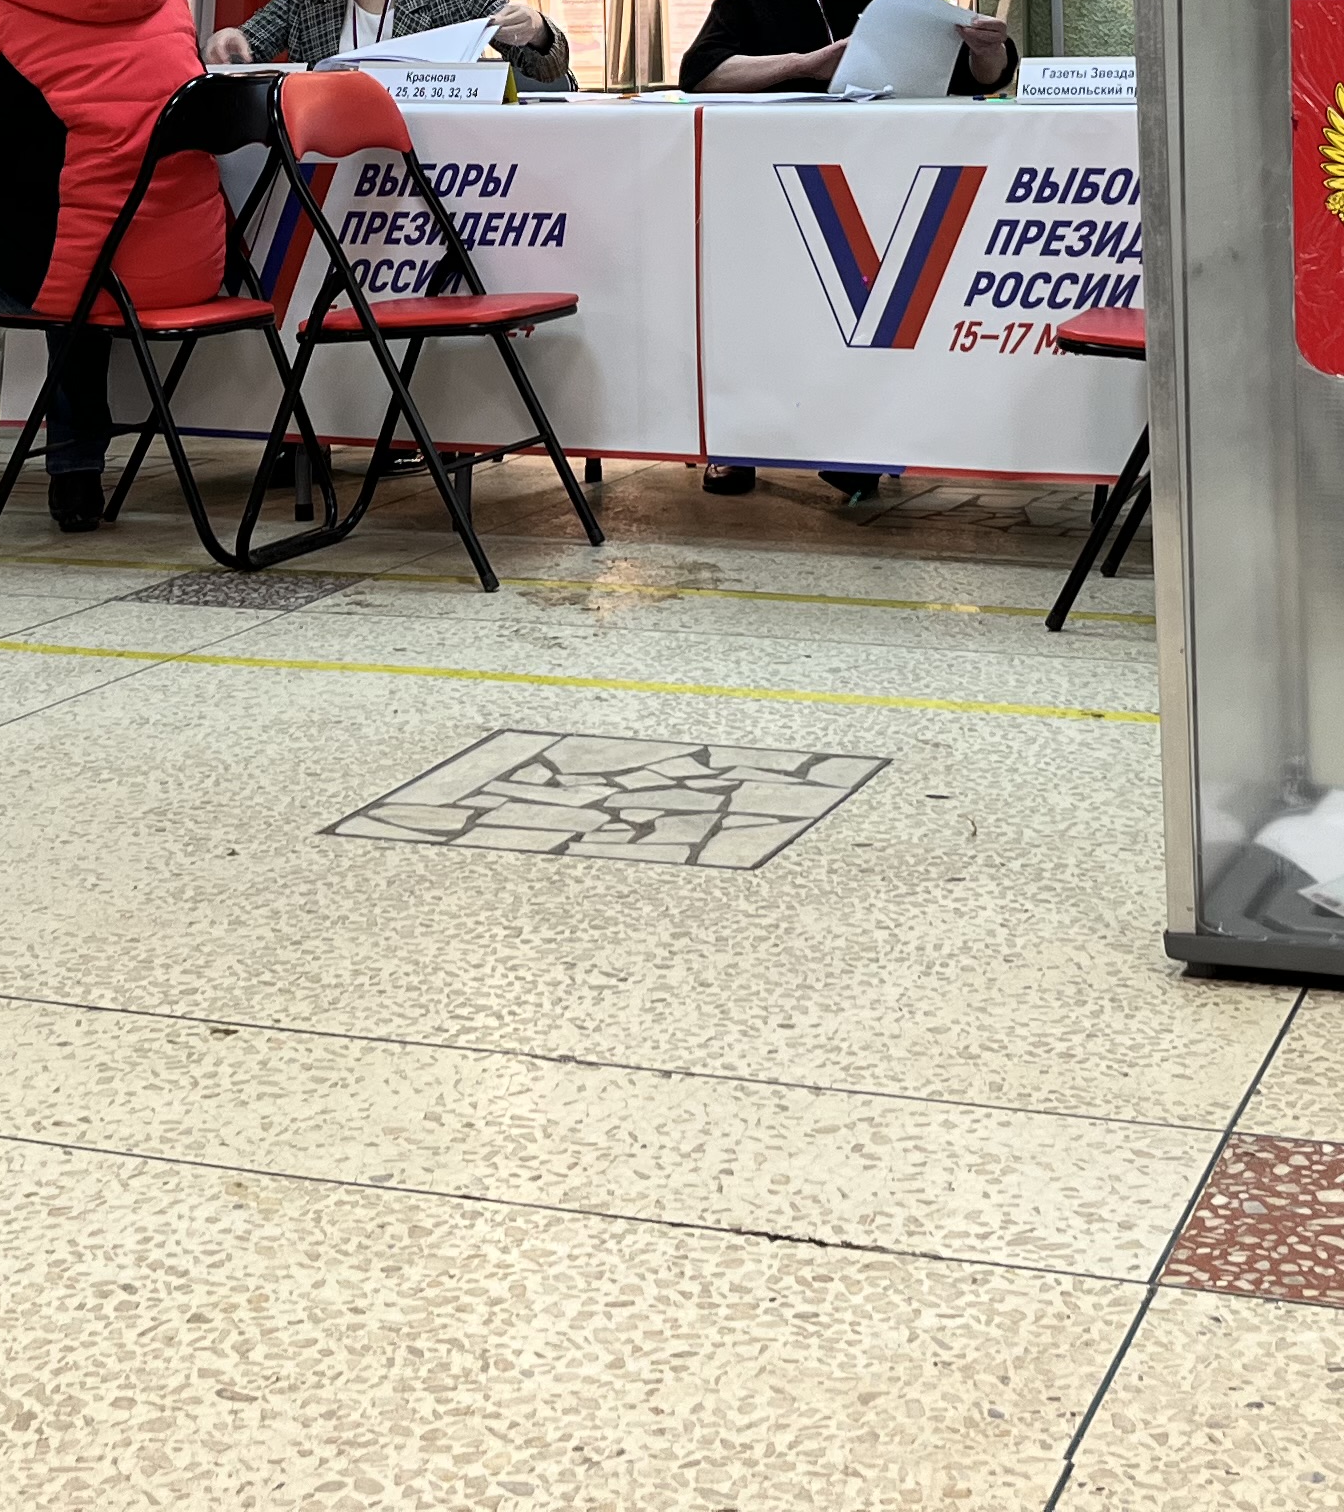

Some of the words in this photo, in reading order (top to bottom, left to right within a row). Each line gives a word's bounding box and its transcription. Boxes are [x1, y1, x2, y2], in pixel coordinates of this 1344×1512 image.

[405, 71, 457, 85] Краснова
[1042, 67, 1087, 79] Газеты
[395, 86, 410, 99] 25,
[412, 86, 427, 99] 26,
[448, 86, 463, 99] 32,
[466, 87, 479, 98] 34
[1022, 83, 1123, 96] Комсомольский
[354, 163, 518, 198] ВЫБОРЫ
[1005, 167, 1140, 206] ВЫБО
[984, 219, 1144, 264] ПРЕЗИД
[963, 271, 1141, 310] РОССИИ
